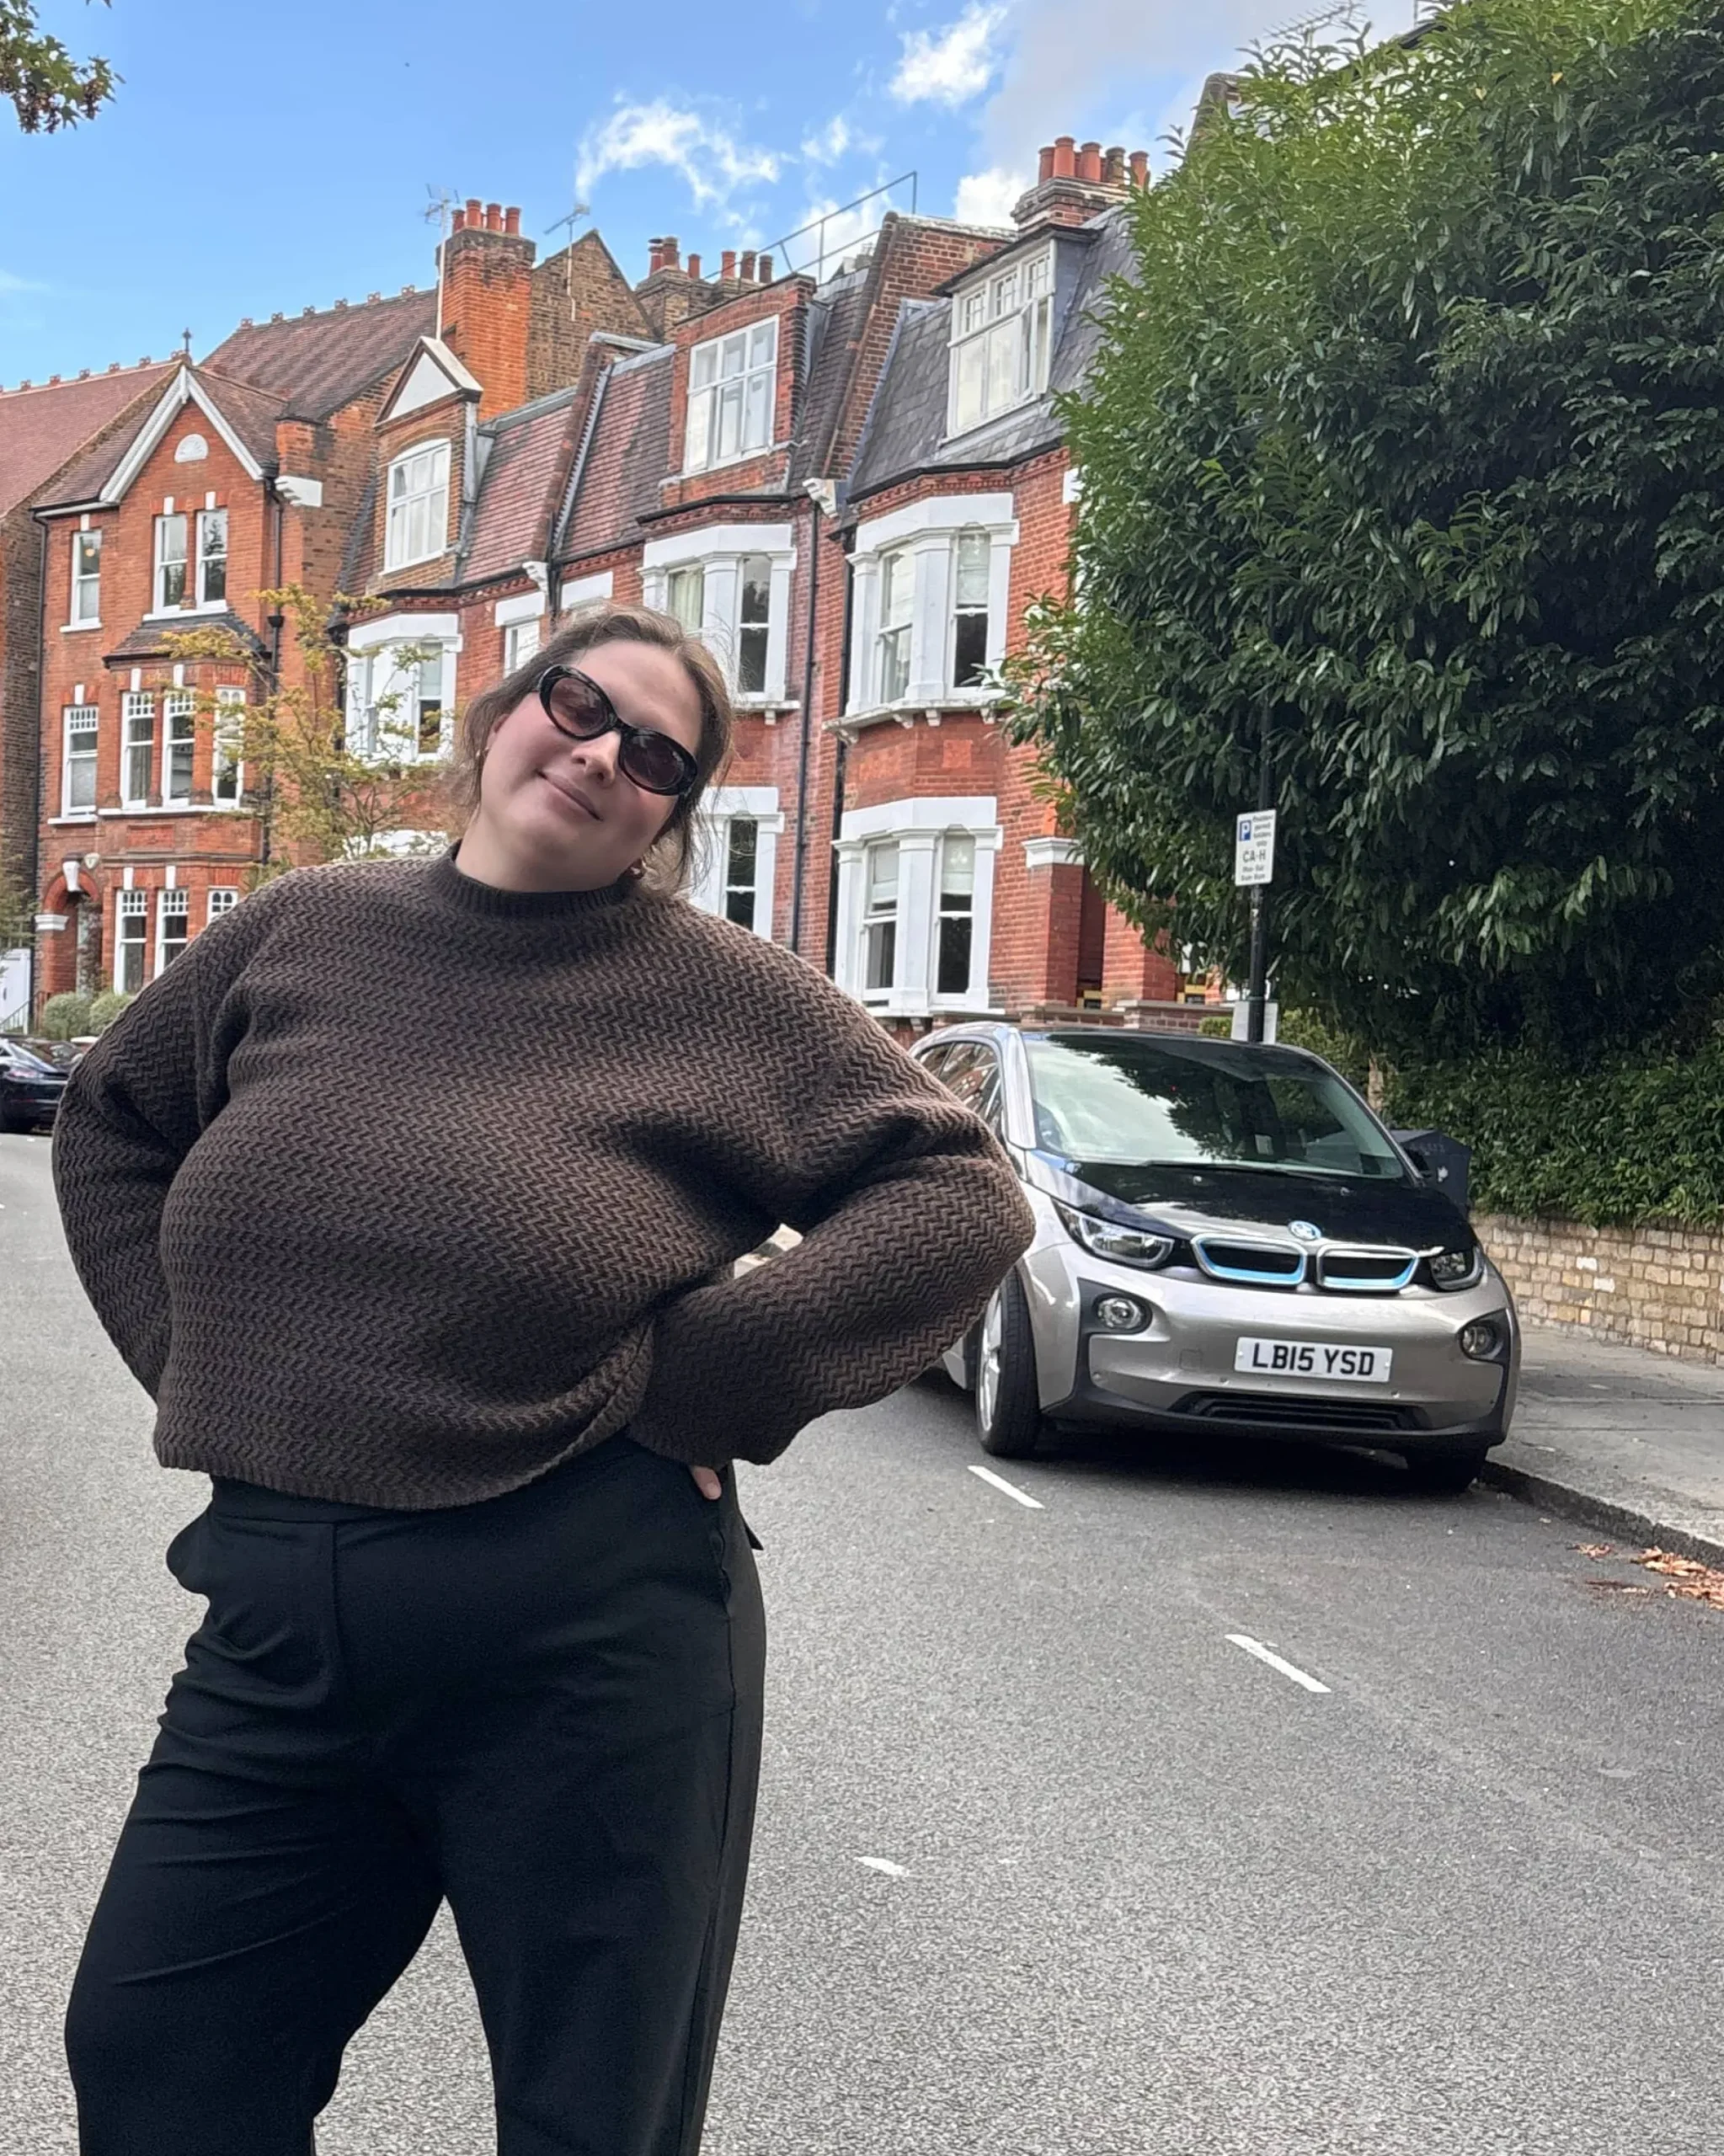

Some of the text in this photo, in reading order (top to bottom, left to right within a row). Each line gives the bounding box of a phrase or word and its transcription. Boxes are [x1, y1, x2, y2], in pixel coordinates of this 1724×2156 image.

[1241, 822, 1250, 841] P
[1252, 1342, 1375, 1377] LB15 YSD
